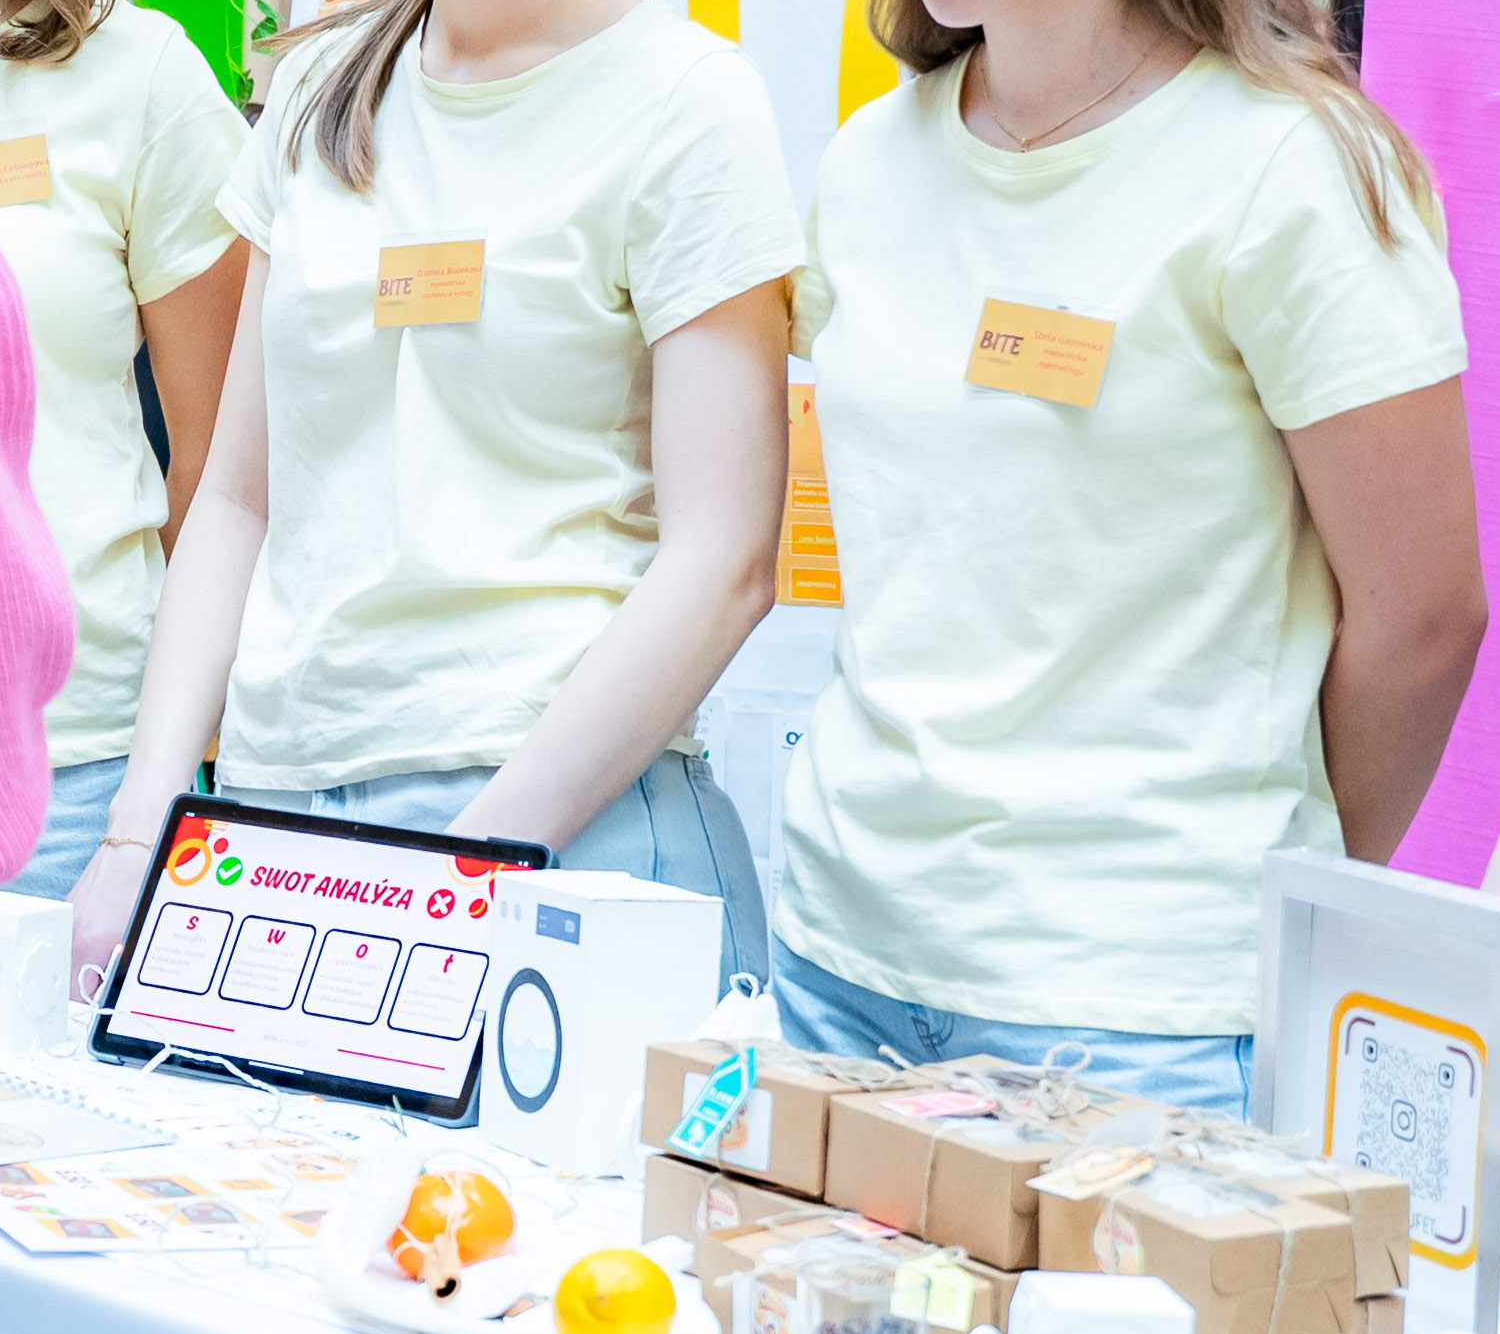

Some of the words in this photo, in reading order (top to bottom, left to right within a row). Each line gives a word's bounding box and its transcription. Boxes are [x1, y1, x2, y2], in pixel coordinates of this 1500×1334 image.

[378, 276, 413, 297] BITE
[980, 330, 1025, 356] BITE
[250, 864, 313, 898] SWOT
[314, 875, 415, 912] ANALÝZA
[186, 915, 200, 930] S
